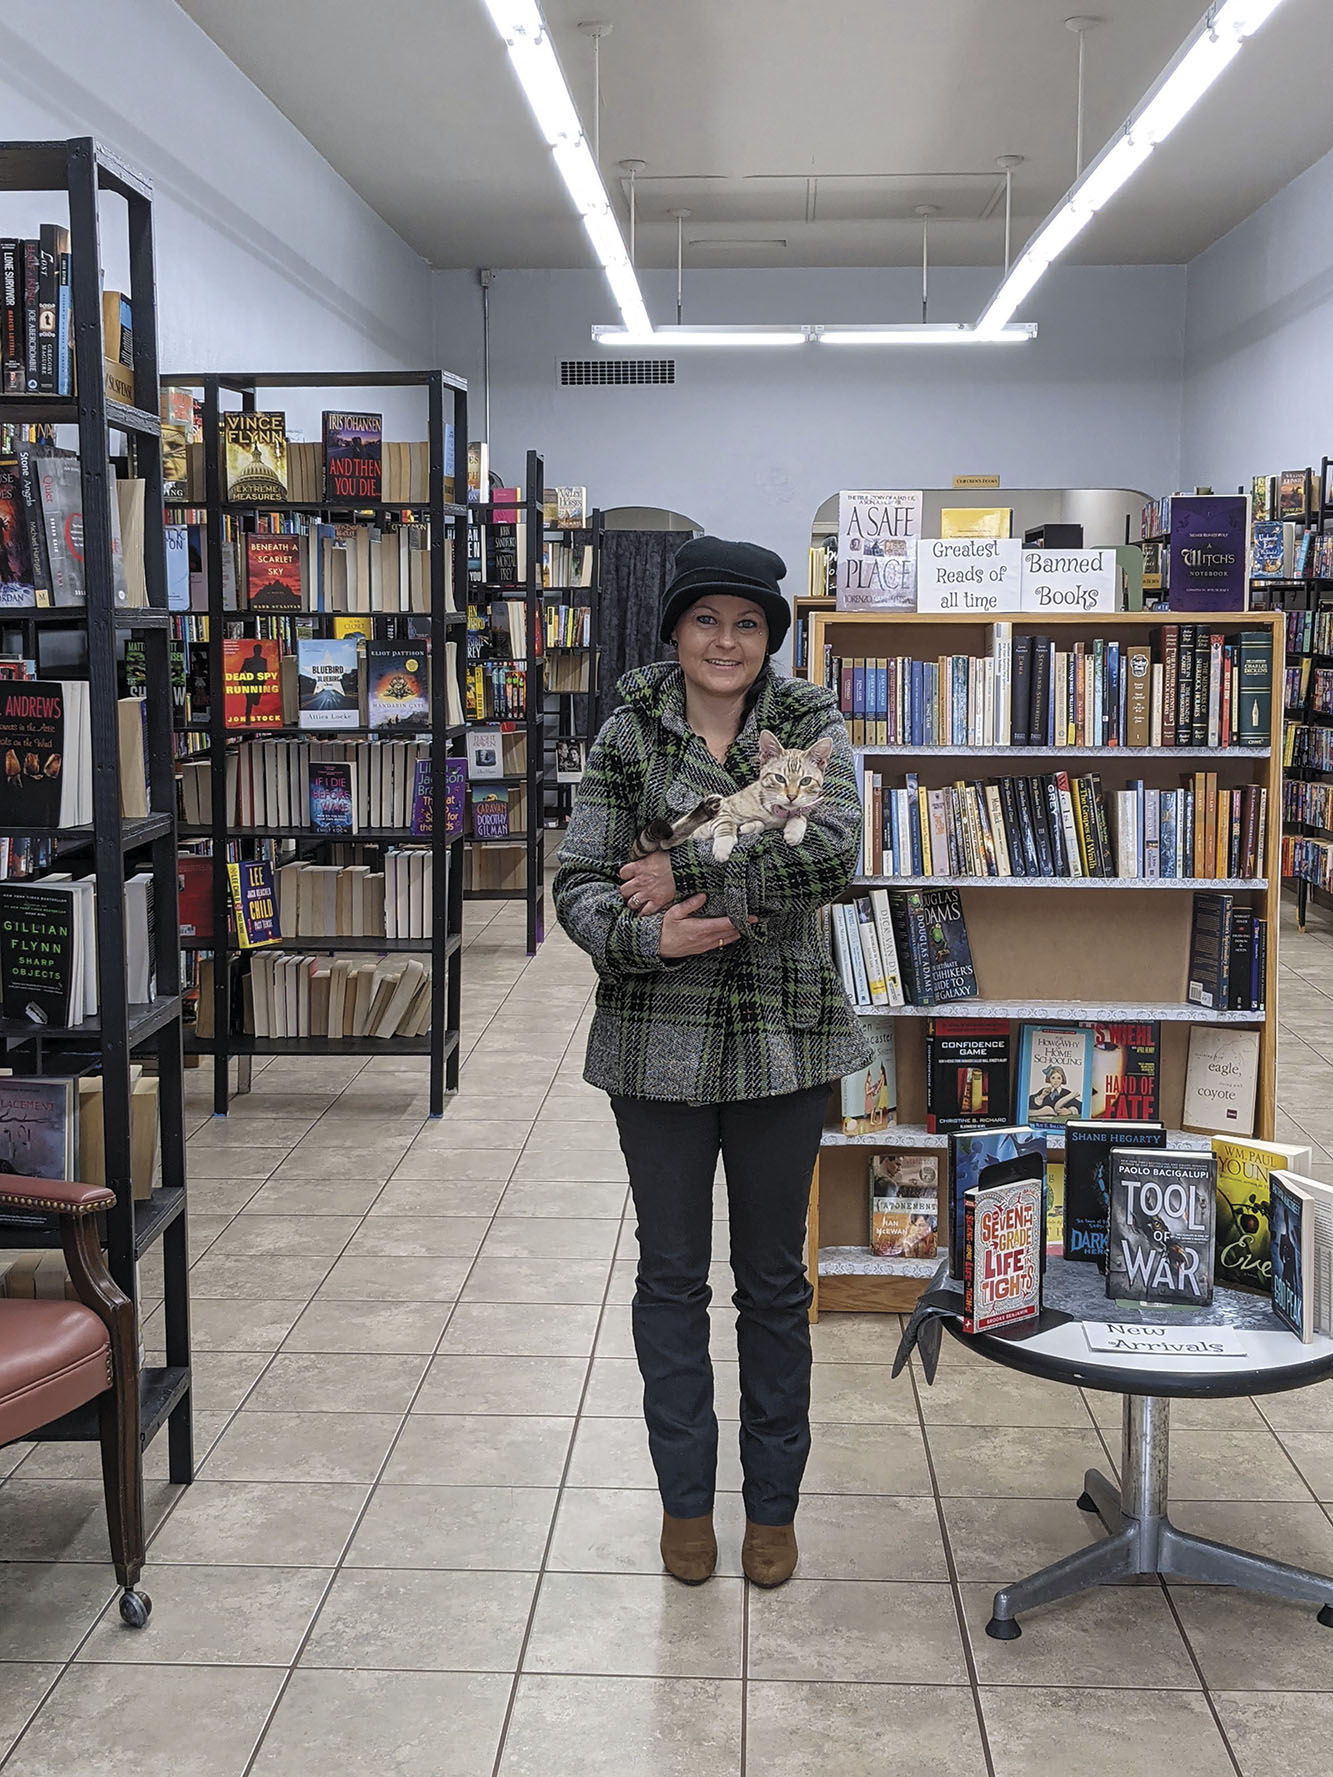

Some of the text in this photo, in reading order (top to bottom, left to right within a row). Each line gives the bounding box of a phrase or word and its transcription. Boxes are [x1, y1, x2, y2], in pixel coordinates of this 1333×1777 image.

[3, 252, 15, 306] LONE SURVIVOR
[28, 309, 36, 372] JOE ABERCROMBIE
[226, 417, 283, 430] VINCE
[329, 414, 381, 432] IRIS JOHANSEN
[228, 430, 284, 444] FLYNN
[330, 458, 382, 475] AND THEN
[19, 452, 35, 507] Stone Angels
[335, 478, 356, 495] YOU
[233, 493, 282, 501] MEASURES
[236, 485, 279, 493] EXTREME
[846, 506, 915, 539] A SAFE
[251, 543, 299, 551] BENEATH A
[932, 539, 1000, 558] Greatest
[257, 555, 293, 564] SCARLET
[1025, 552, 1104, 574] Banned
[267, 567, 284, 576] SKY
[500, 568, 513, 581] PREY
[845, 558, 912, 591] PLACE
[936, 565, 1008, 584] Reads of
[940, 591, 998, 612] all time
[1035, 584, 1099, 611] Books
[1037, 653, 1045, 674] SENSE
[225, 672, 278, 682] DEAD SPY
[225, 685, 280, 695] RUNNING
[1194, 658, 1203, 717] SHERLOCK HOLMES
[5, 696, 62, 719] ANDREWS
[330, 712, 352, 720] Locke
[1034, 691, 1042, 732] SENSIBILITY
[314, 777, 324, 786] IF
[331, 777, 347, 787] DIE
[1003, 778, 1011, 790] Fifty
[312, 790, 351, 800] BEFORE
[1033, 790, 1041, 806] Shades
[1047, 784, 1057, 816] GREY
[1057, 775, 1068, 805] Woe
[1063, 809, 1071, 822] Is
[321, 801, 349, 812] WAKE
[476, 803, 508, 814] CARAVAN
[991, 797, 1001, 824] Moby Dick
[477, 814, 507, 825] DOROTHY
[477, 824, 508, 836] GILMAN
[1079, 788, 1097, 869] The Grapes of Wrath
[231, 874, 239, 884] LEE
[249, 866, 265, 887] LEE
[249, 899, 274, 921] CHILD
[3, 920, 68, 937] GILLIAN
[880, 909, 891, 934] DICK
[1224, 911, 1232, 934] Women's
[11, 939, 61, 954] FLYNN
[885, 936, 894, 957] VAN
[917, 914, 933, 993] DOUGLAS ADAMS
[1223, 935, 1231, 965] Spirituality
[18, 956, 55, 966] SHARP
[12, 967, 61, 980] OBJECTS
[951, 977, 965, 988] TO
[940, 985, 972, 1000] GALAXY
[1107, 1023, 1156, 1047] WIEHL
[941, 1041, 1005, 1049] CONFIDENCE
[1045, 1047, 1073, 1058] HOME
[1033, 1054, 1082, 1066] SCHOOLING
[1208, 1062, 1242, 1077] eagle,
[1105, 1074, 1156, 1095] HAND OF
[1197, 1087, 1237, 1101] coyote
[1104, 1094, 1155, 1120] FATE
[1071, 1131, 1162, 1144] SHANE HEGARTY
[1224, 1145, 1277, 1168] WM. PAUL
[1118, 1166, 1209, 1179] PAOLO BACIGALUPI
[1218, 1157, 1270, 1184] YOUN
[877, 1200, 937, 1213] ATONEMENT
[1121, 1180, 1206, 1232] TOOL
[982, 1205, 1033, 1242] SEVENTH
[1000, 1227, 1032, 1252] GRADE
[1153, 1230, 1171, 1242] OF
[984, 1249, 1024, 1280] LIFE
[1220, 1234, 1272, 1278] Eve
[1121, 1239, 1201, 1297] WAR
[981, 1264, 1034, 1306] TIGHTS
[1006, 1309, 1029, 1321] BENJAMIN
[1106, 1324, 1167, 1337] New
[1107, 1339, 1224, 1353] Arrivals
